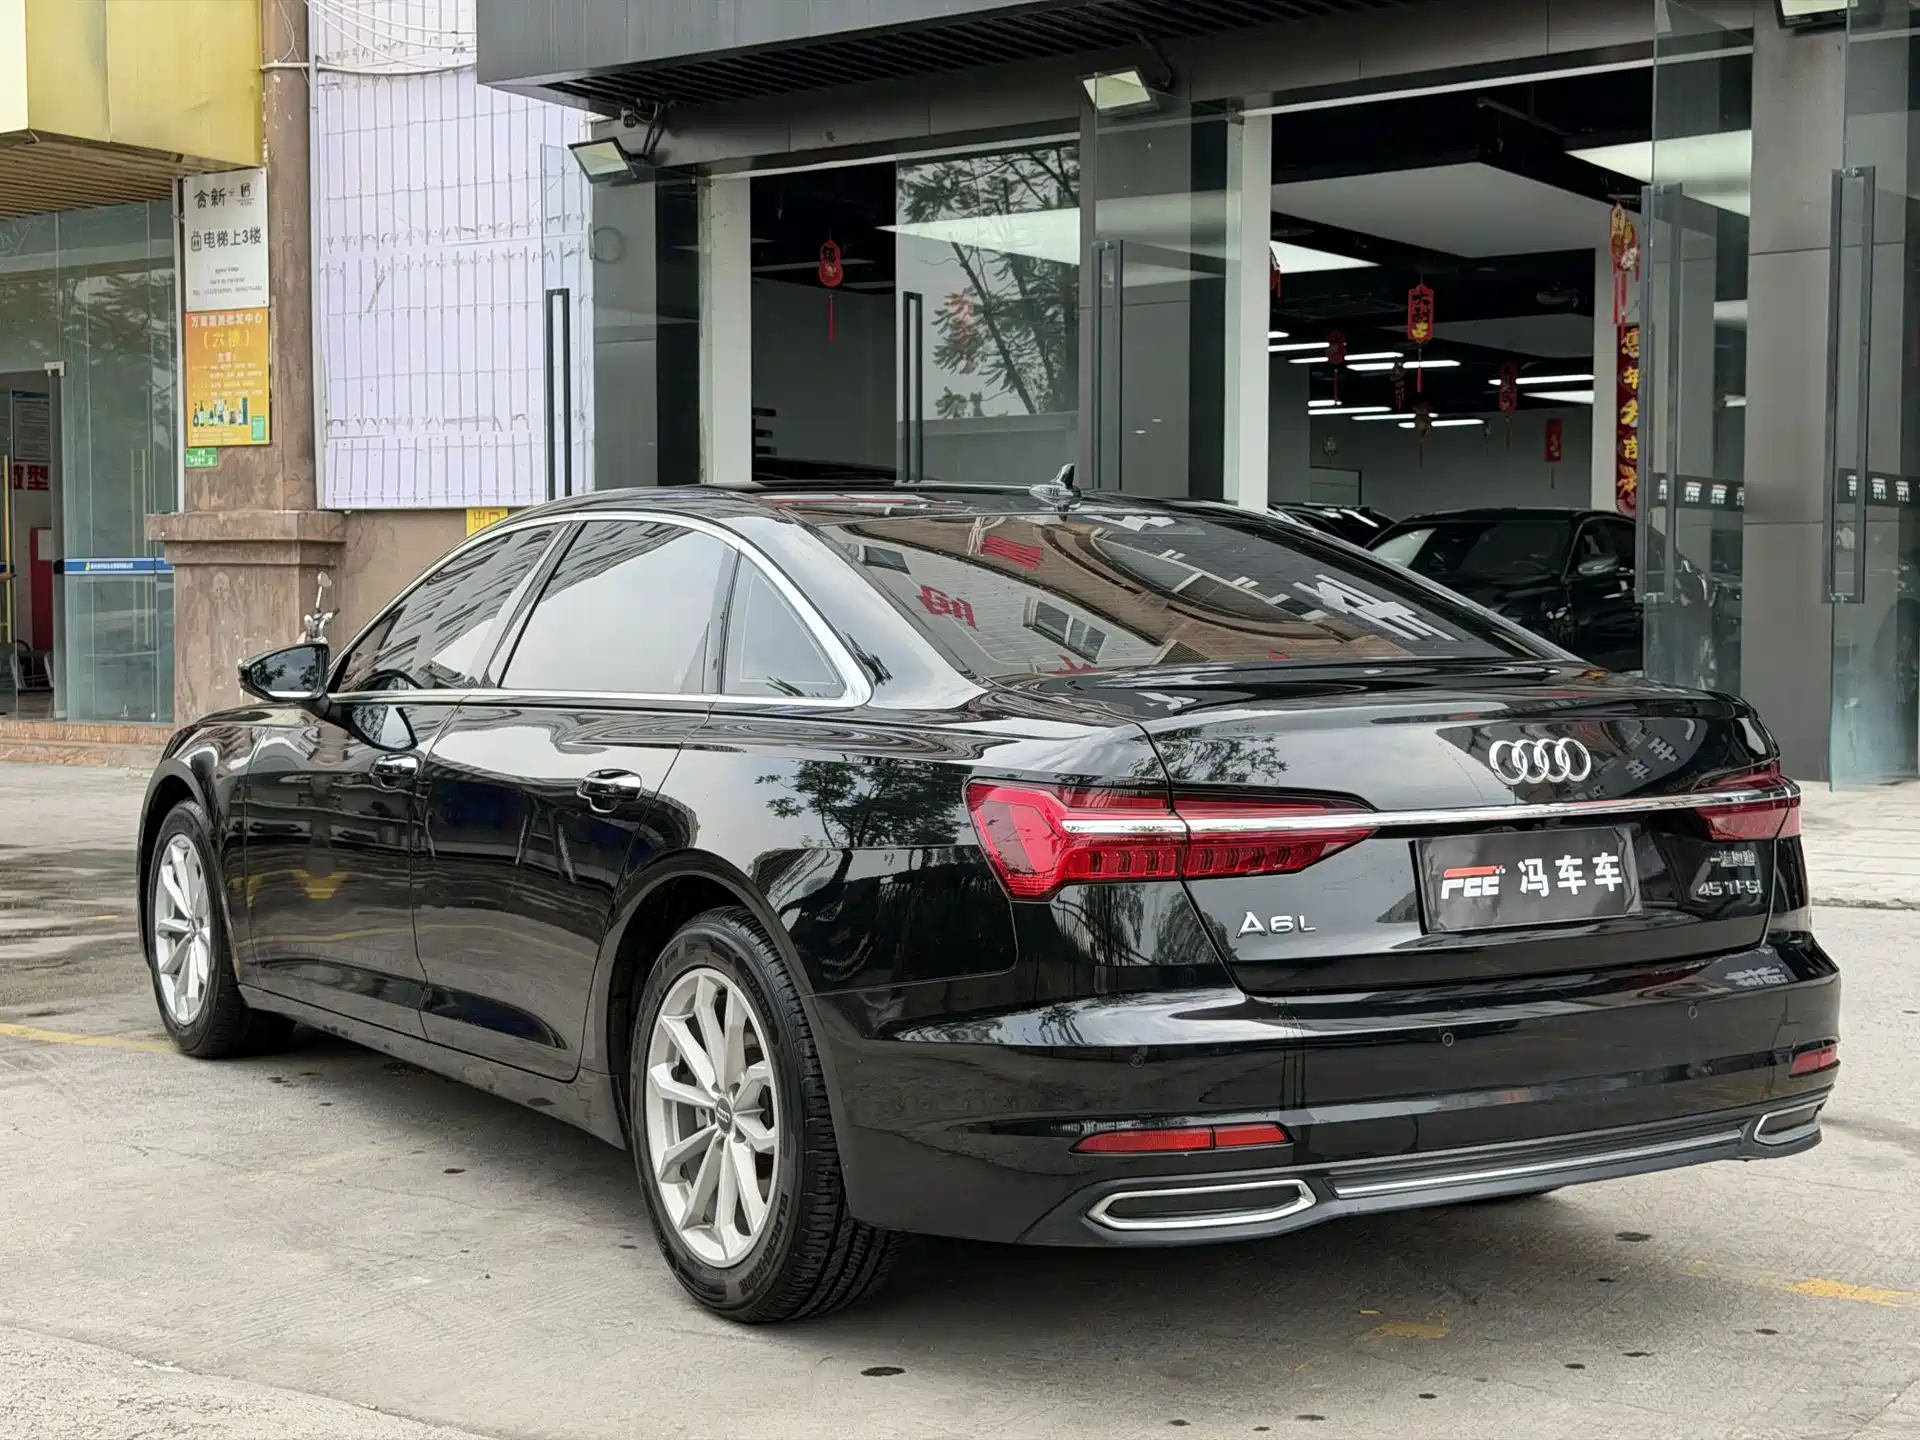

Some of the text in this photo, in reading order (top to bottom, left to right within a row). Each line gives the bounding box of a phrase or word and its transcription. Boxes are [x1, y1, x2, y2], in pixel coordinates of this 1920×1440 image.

[203, 227, 262, 249] 电梯上3楼
[1517, 852, 1623, 897] 冯车车
[1698, 881, 1723, 896] 45
[1236, 911, 1317, 938] A6L
